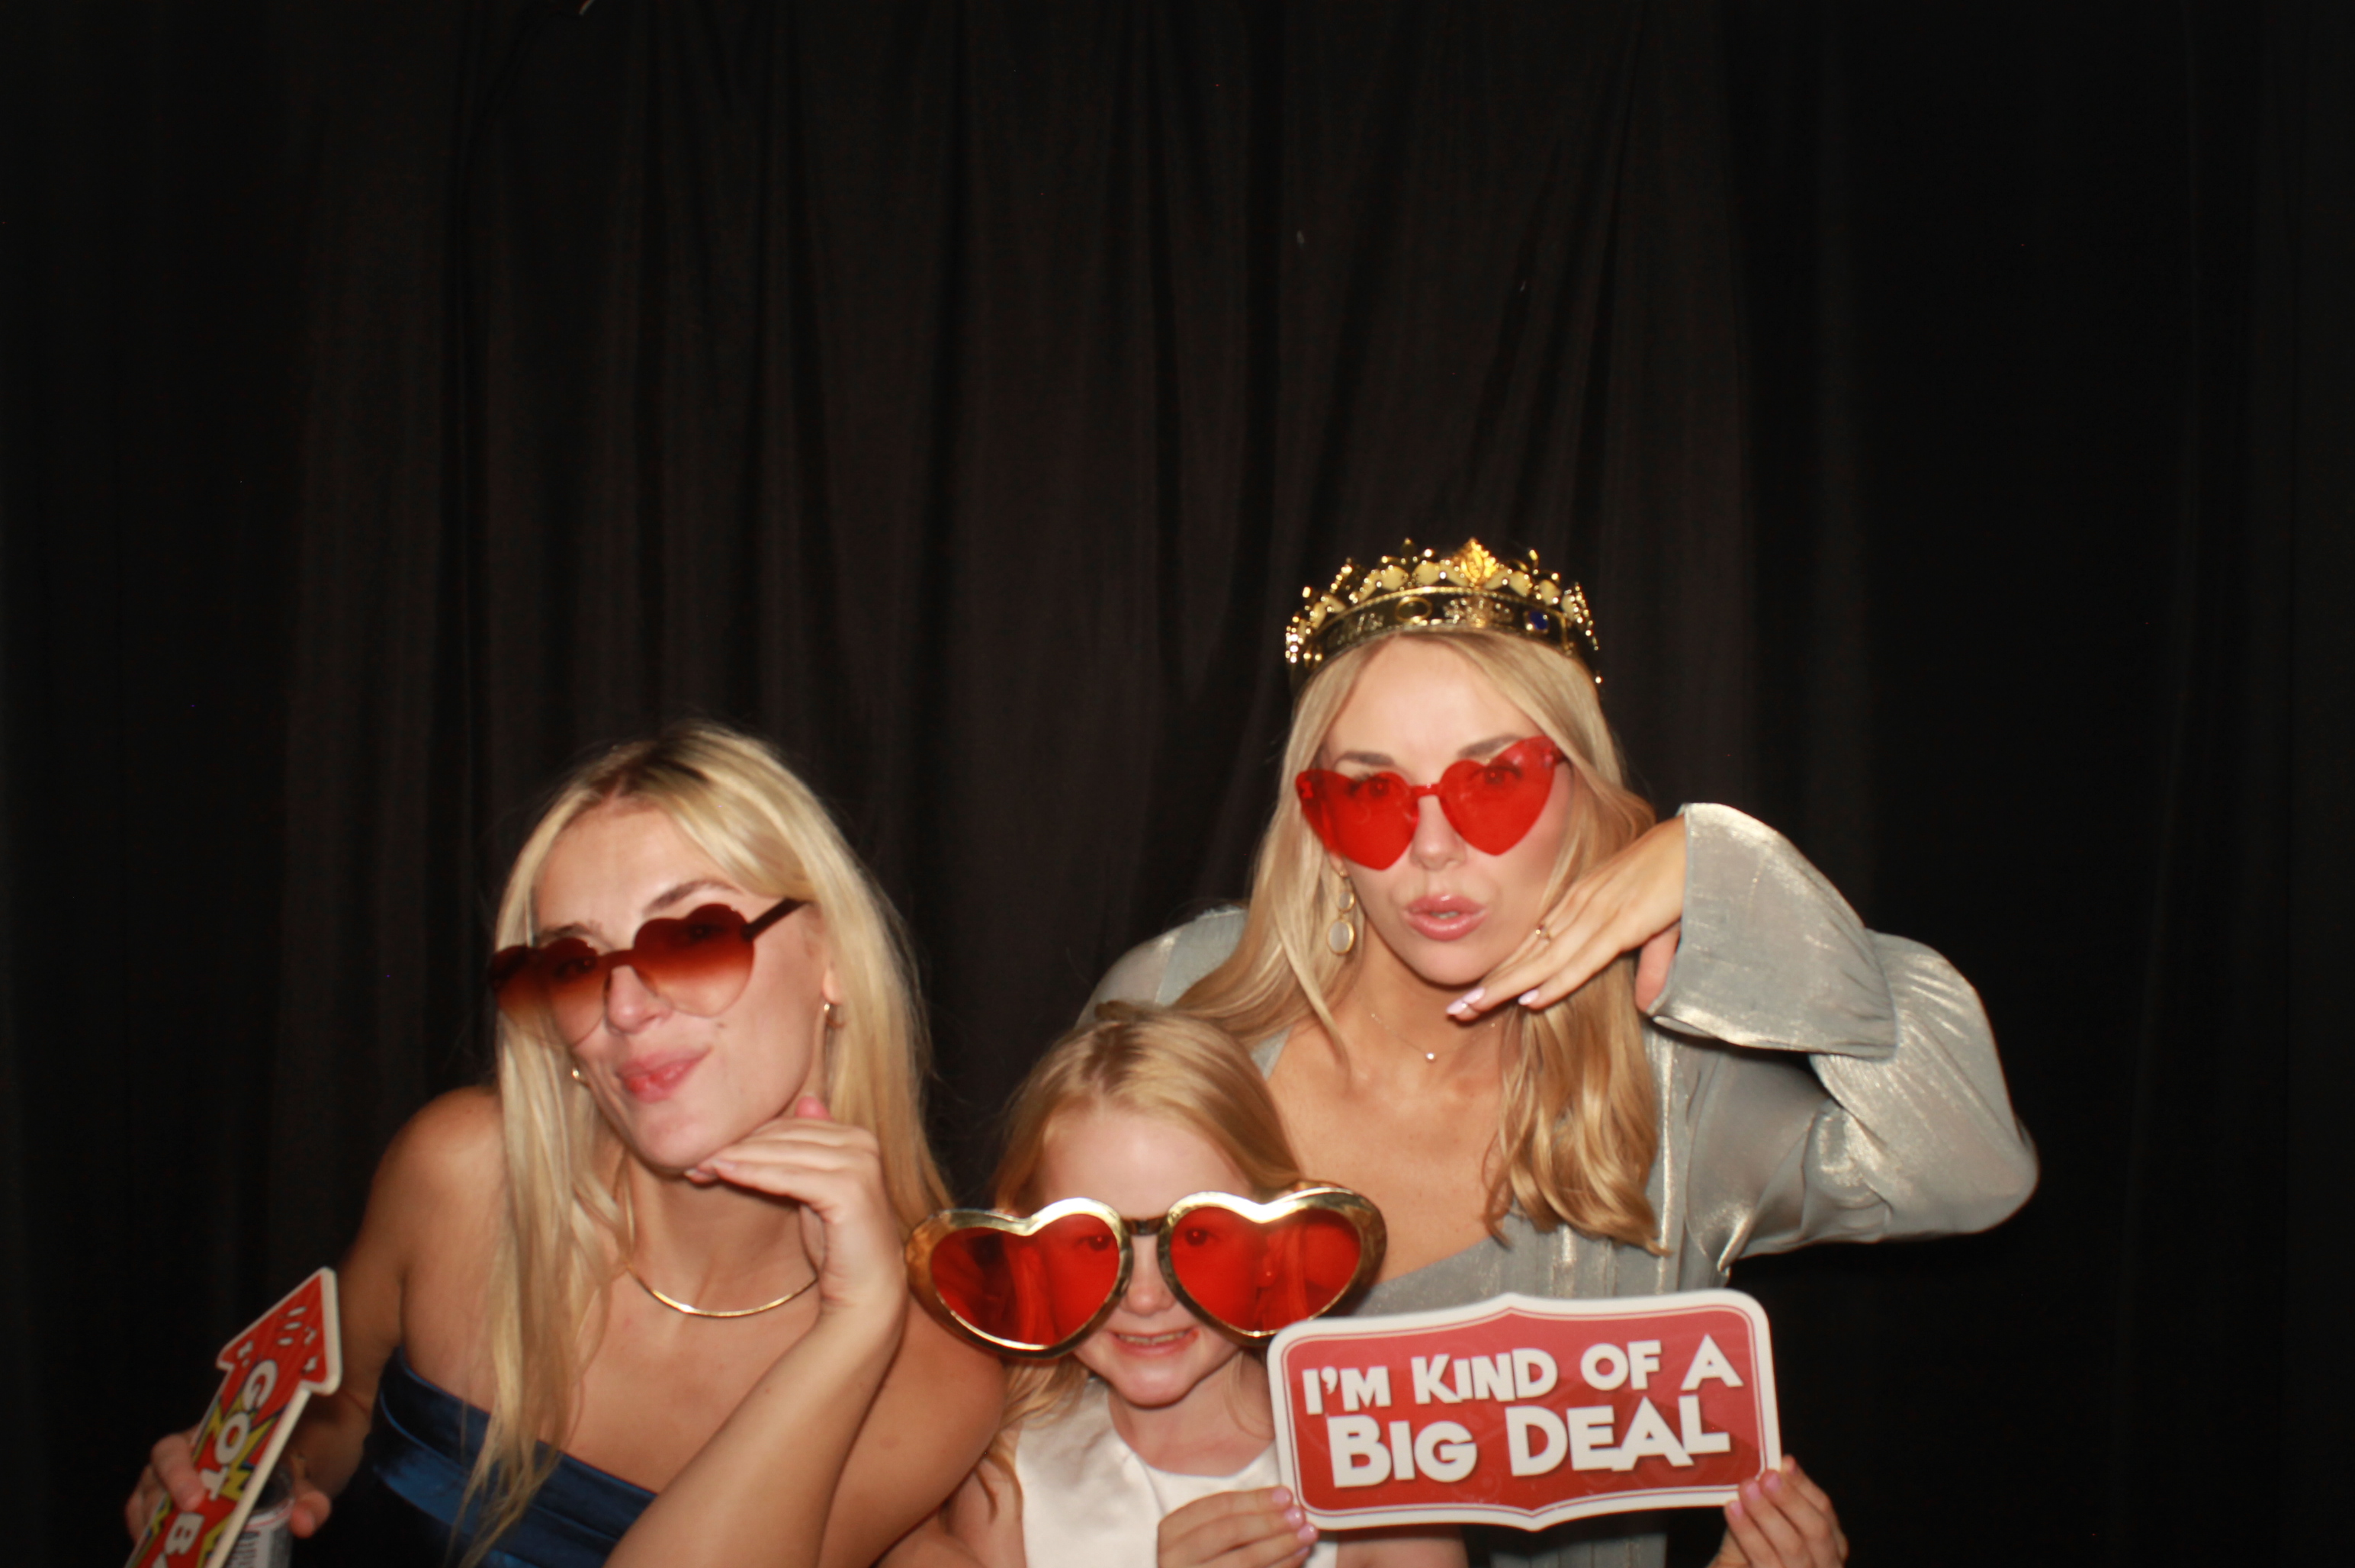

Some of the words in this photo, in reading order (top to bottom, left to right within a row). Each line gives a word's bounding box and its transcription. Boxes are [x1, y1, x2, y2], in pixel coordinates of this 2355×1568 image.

[1302, 1366, 1392, 1415] I'M
[1411, 1348, 1558, 1405] KIND
[1580, 1340, 1662, 1390] OF
[1680, 1333, 1743, 1390] A
[201, 1359, 278, 1501] GOT
[1326, 1414, 1477, 1488] BIG
[1504, 1394, 1730, 1477] DEAL
